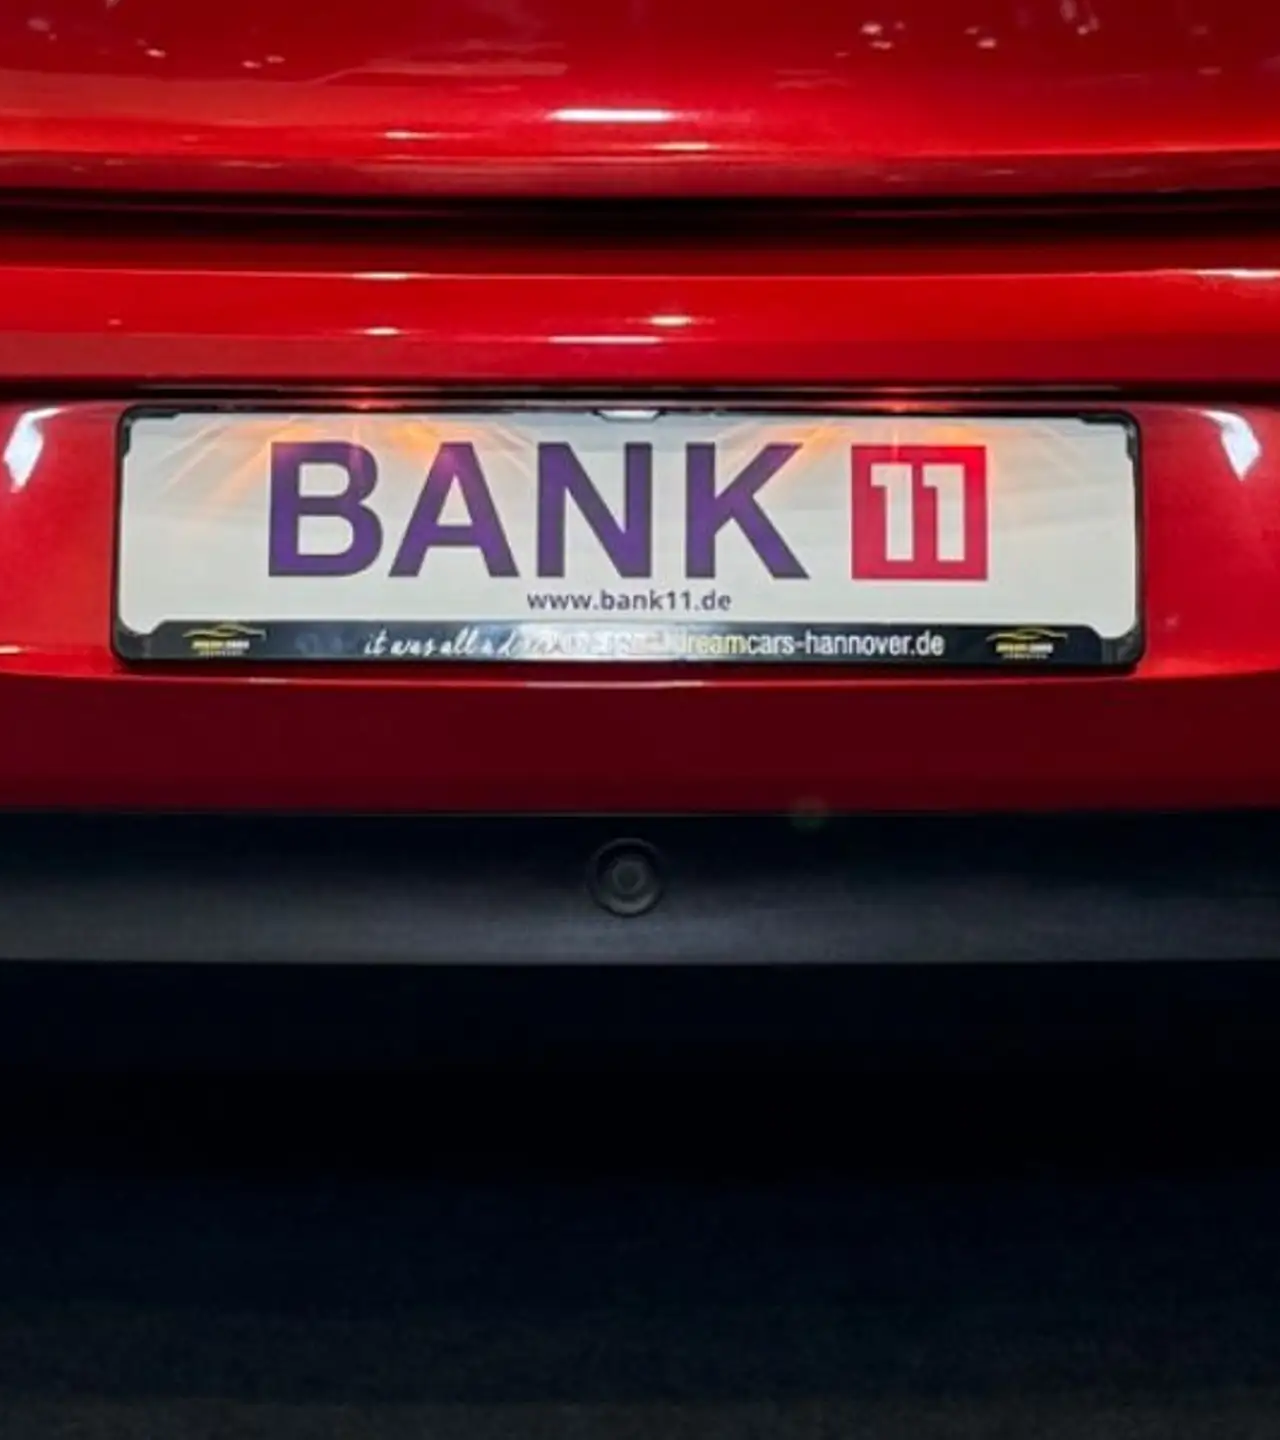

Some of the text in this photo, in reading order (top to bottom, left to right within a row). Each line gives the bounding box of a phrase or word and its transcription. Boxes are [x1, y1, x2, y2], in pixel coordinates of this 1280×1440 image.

[268, 441, 968, 579] BANK 11
[526, 588, 733, 612] www.bank11.de
